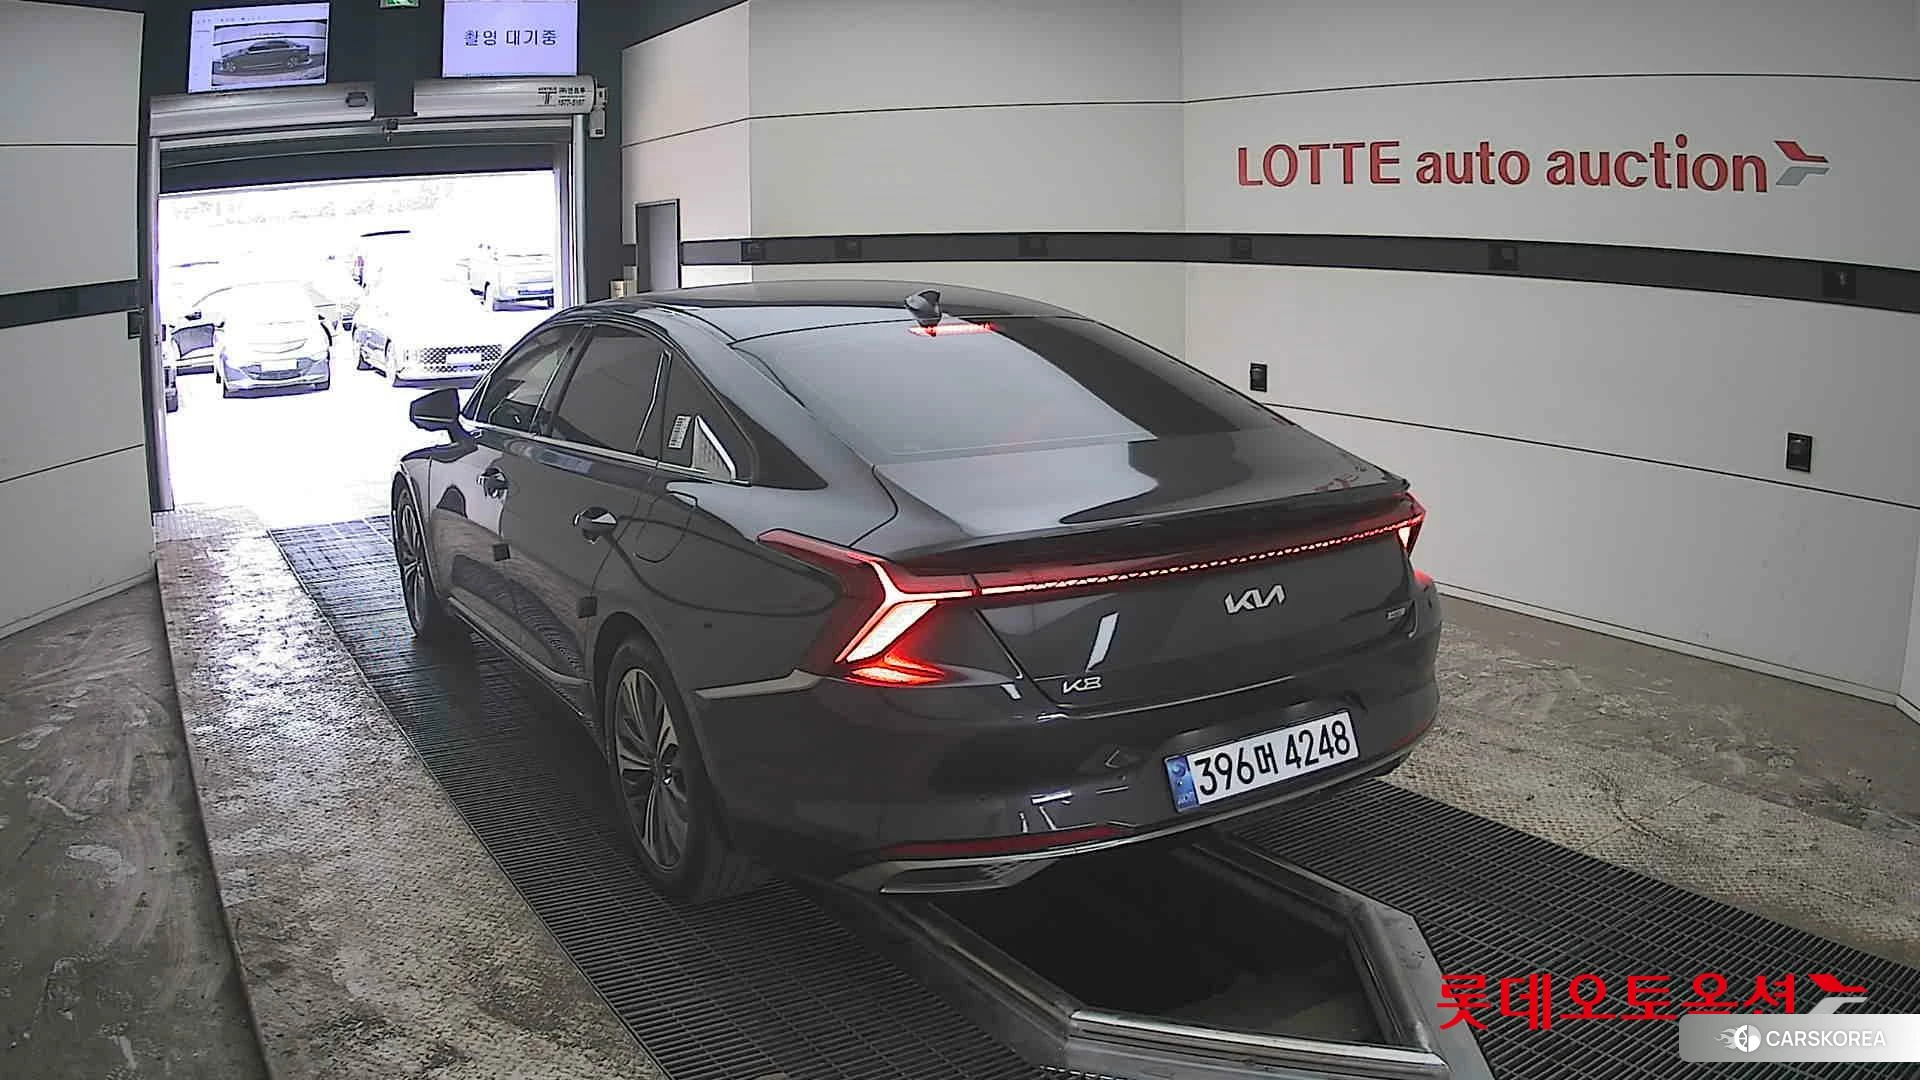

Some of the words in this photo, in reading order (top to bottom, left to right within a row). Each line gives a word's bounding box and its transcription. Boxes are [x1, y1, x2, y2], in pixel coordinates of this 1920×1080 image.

[505, 29, 557, 46] 대기중
[1238, 140, 1400, 187] LOTTE
[1416, 142, 1530, 185] auto
[1546, 134, 1767, 193] auction
[1225, 584, 1286, 614] KIA
[1063, 676, 1102, 694] K8
[1194, 742, 1279, 796] 396머
[1285, 720, 1351, 769] 4248
